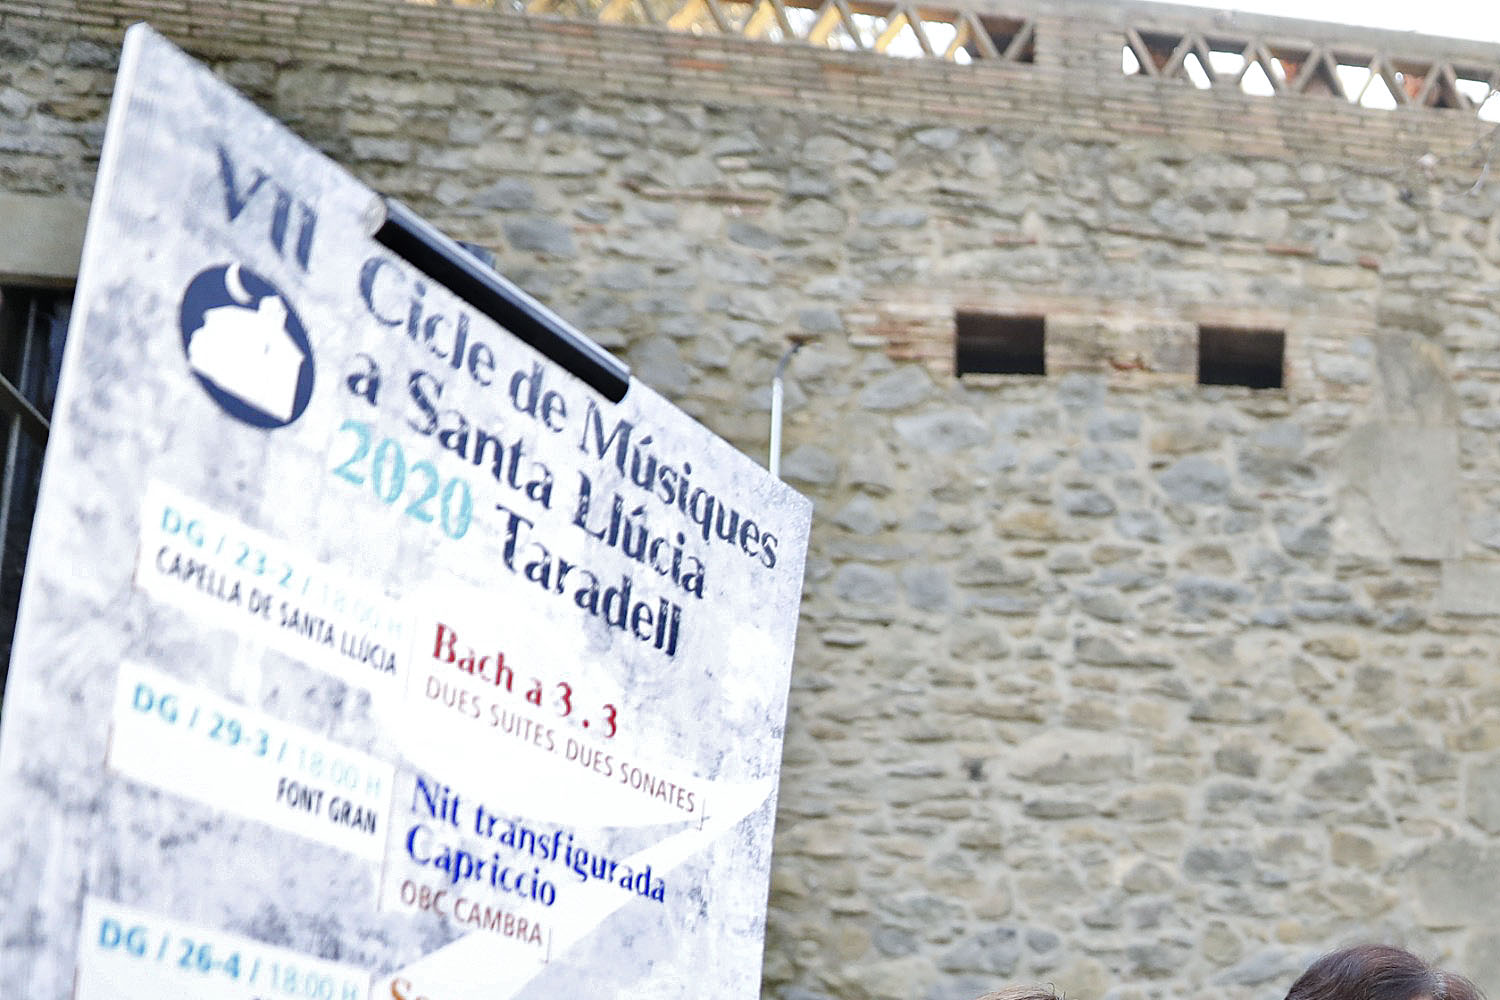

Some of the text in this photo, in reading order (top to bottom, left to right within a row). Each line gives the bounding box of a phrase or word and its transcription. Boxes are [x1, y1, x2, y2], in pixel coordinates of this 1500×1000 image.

[213, 143, 779, 570] VII Cicle de Músiques
[346, 353, 705, 600] a Santa Llúcia
[161, 505, 204, 548] DG
[332, 419, 683, 658] 2020 Taradell
[155, 544, 243, 606] CAPELLA
[248, 587, 274, 621] DE
[279, 600, 335, 648] SANTA
[431, 622, 514, 693] Bach
[524, 676, 543, 707] a
[133, 682, 178, 725] DG
[209, 711, 270, 758] 29-3
[425, 675, 482, 720] DUES
[565, 737, 613, 778] DUES
[619, 761, 696, 815] SONATES
[275, 776, 379, 837] FONT GRAN
[411, 774, 667, 904] Nit transfigurada
[406, 822, 556, 907] Capriccio
[98, 917, 148, 960] DG
[177, 937, 242, 981] 26-4
[401, 878, 544, 947] OBC CAMBRA
